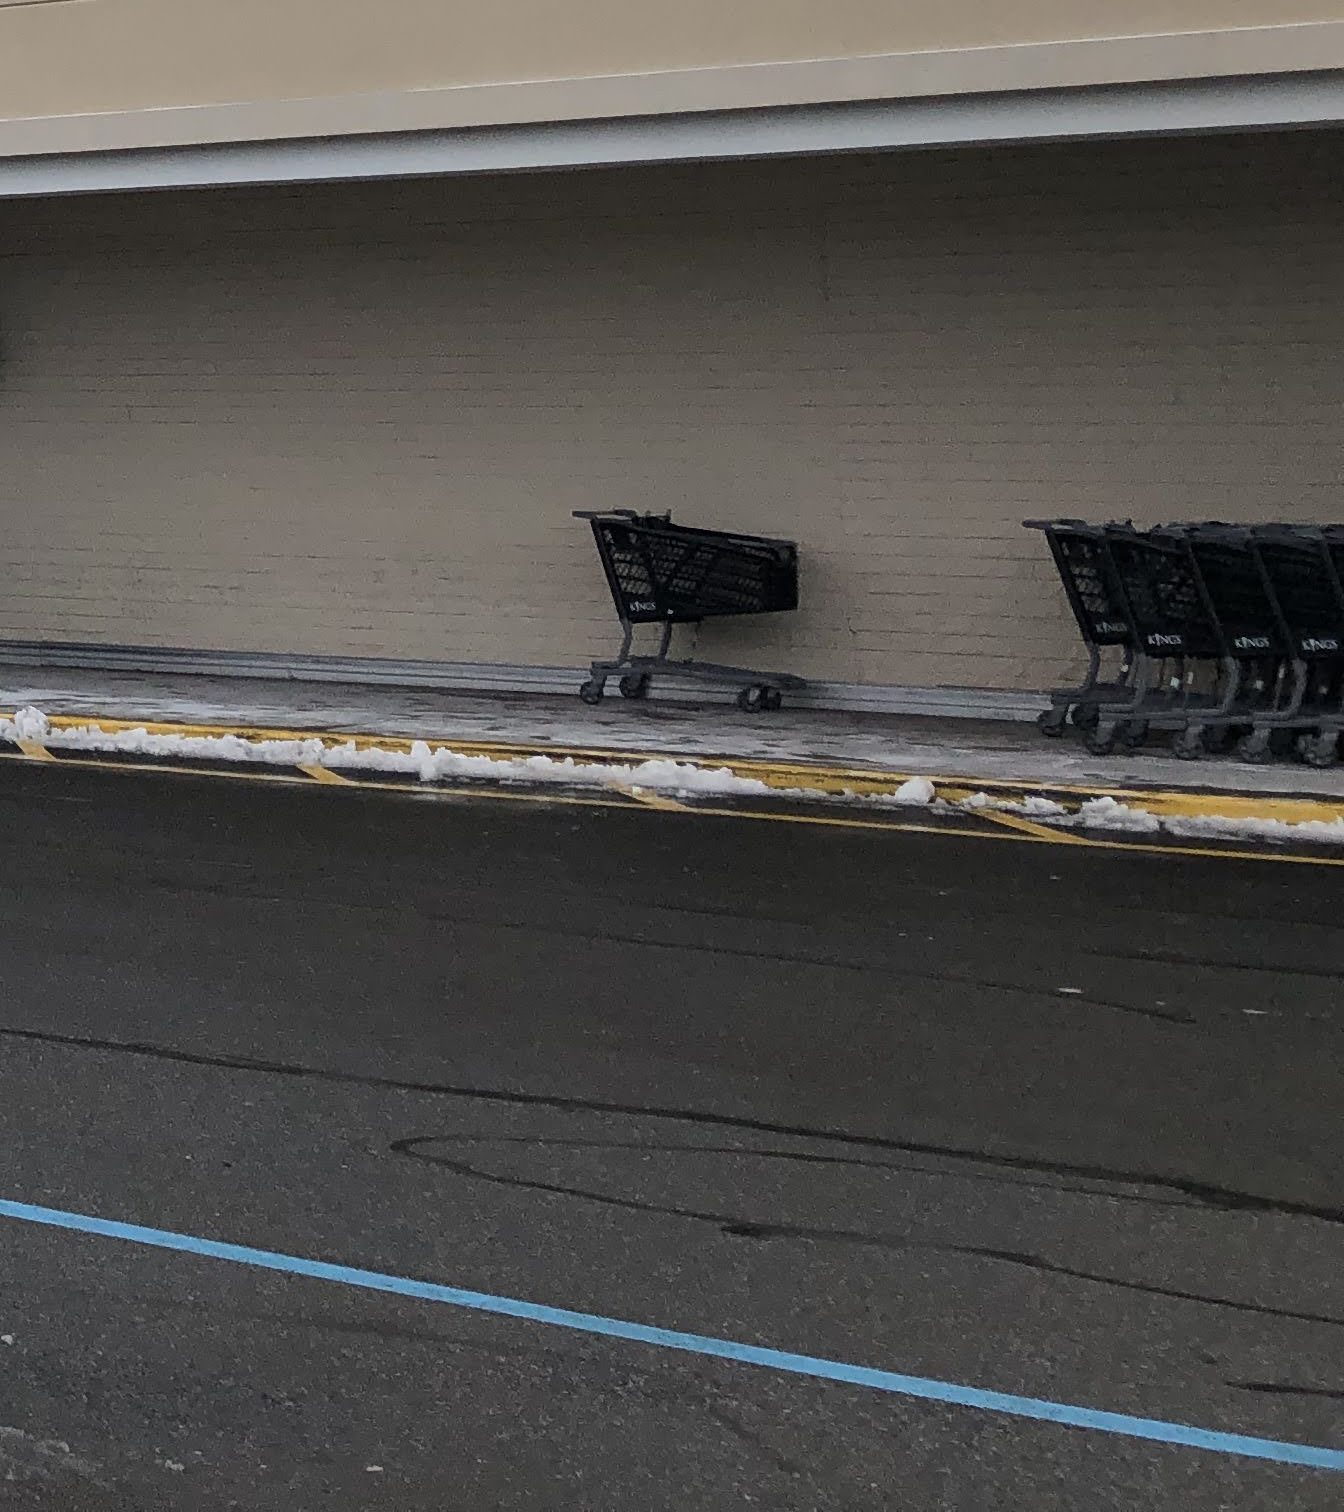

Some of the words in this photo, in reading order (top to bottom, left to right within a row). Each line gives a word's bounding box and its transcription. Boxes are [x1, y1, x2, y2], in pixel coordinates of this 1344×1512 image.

[1148, 633, 1182, 647] KINGS
[1235, 636, 1270, 649] KINGS
[1301, 638, 1338, 651] KINGS
